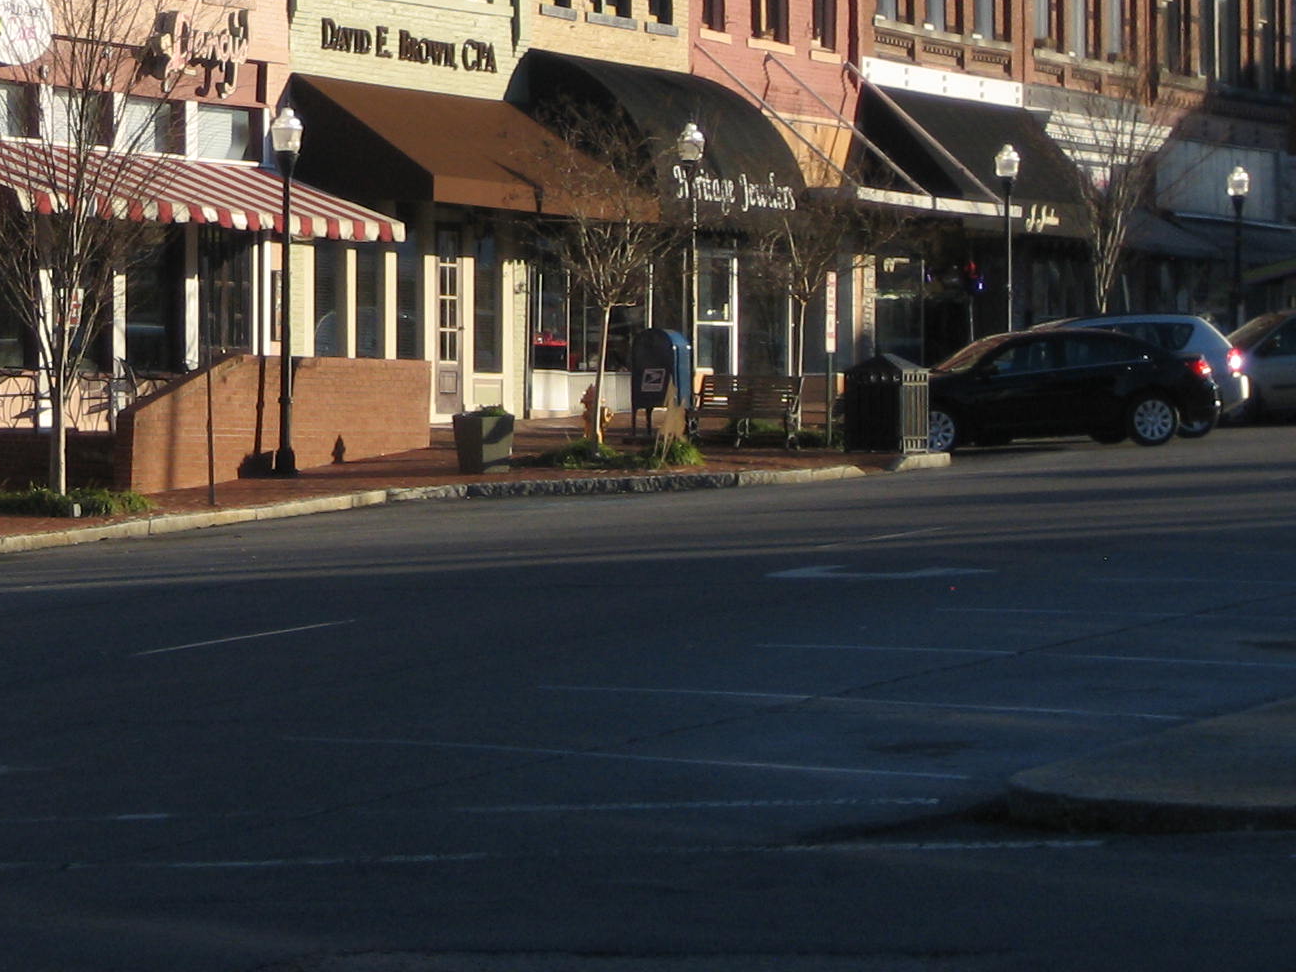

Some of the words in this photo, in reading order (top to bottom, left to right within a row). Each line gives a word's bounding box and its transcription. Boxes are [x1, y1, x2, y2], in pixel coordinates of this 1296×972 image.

[321, 17, 373, 55] DAVID
[375, 25, 393, 59] E.
[398, 28, 459, 71] BROWN,
[461, 38, 498, 74] CPA
